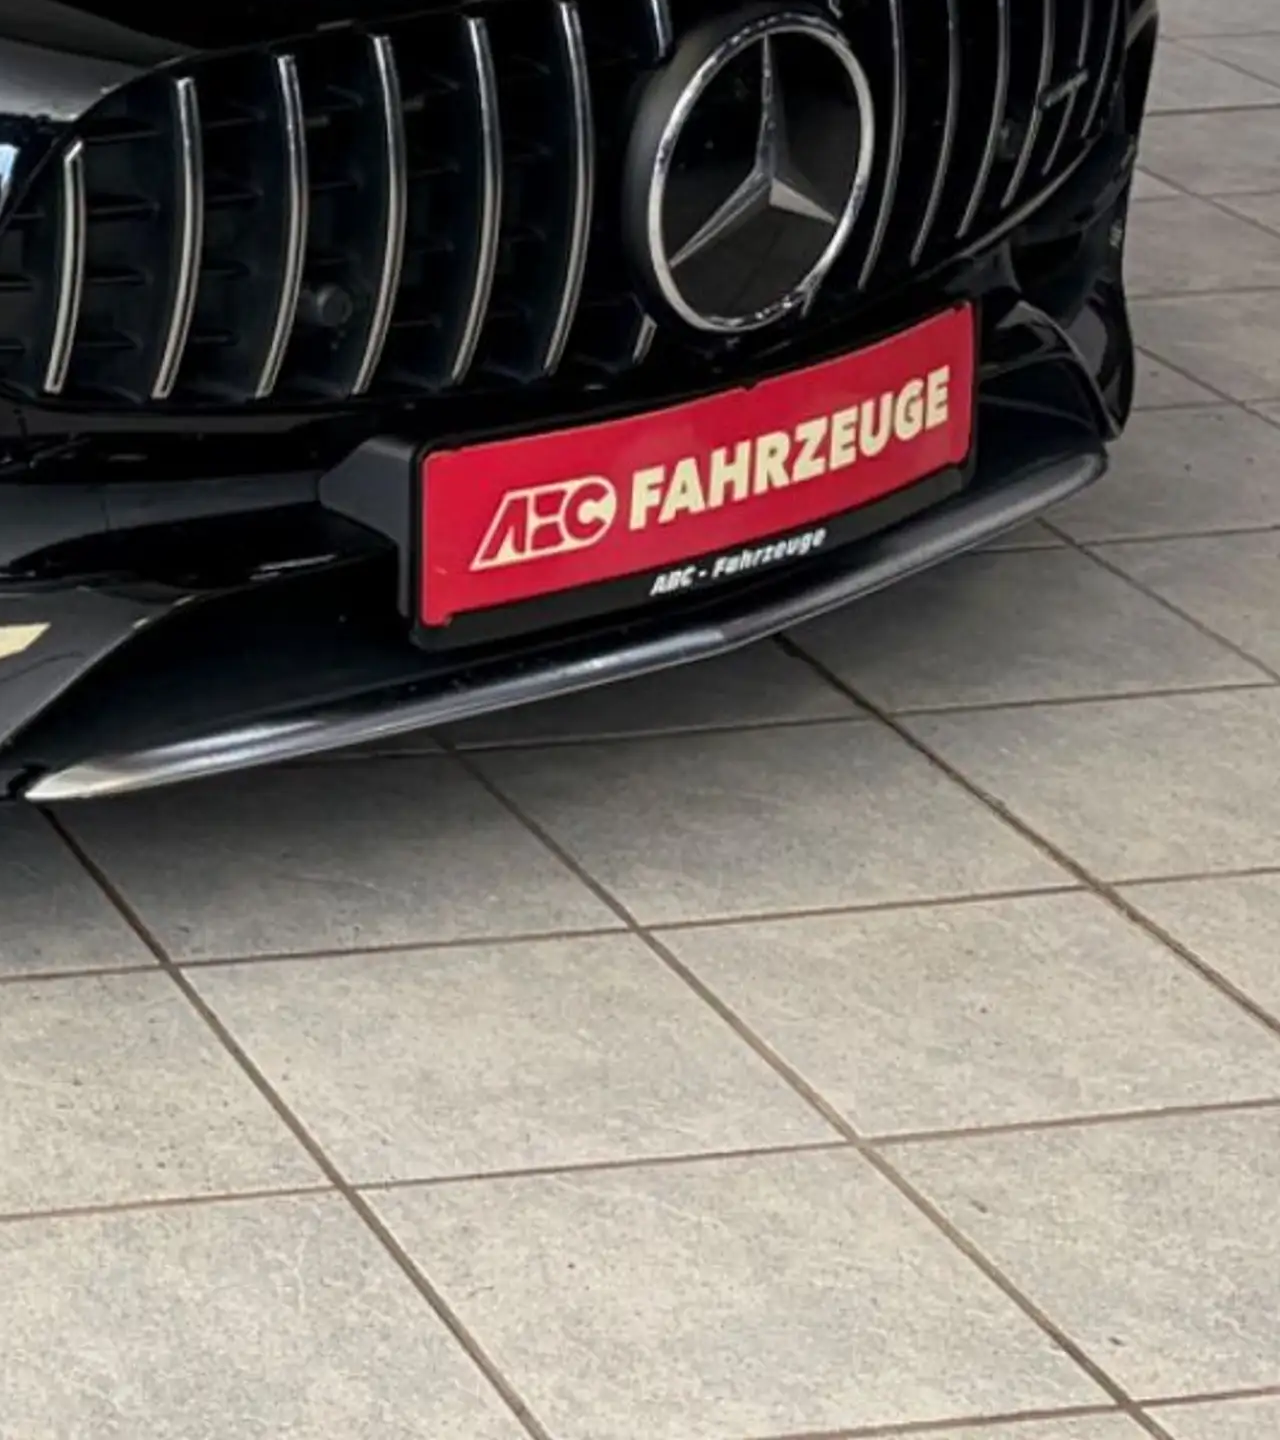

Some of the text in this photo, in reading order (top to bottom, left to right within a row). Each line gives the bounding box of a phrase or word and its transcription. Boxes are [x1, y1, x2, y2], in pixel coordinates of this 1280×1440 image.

[628, 365, 951, 530] FAHRZEUGE
[649, 565, 696, 596] ABC
[711, 527, 827, 580] Fahrzeuge
